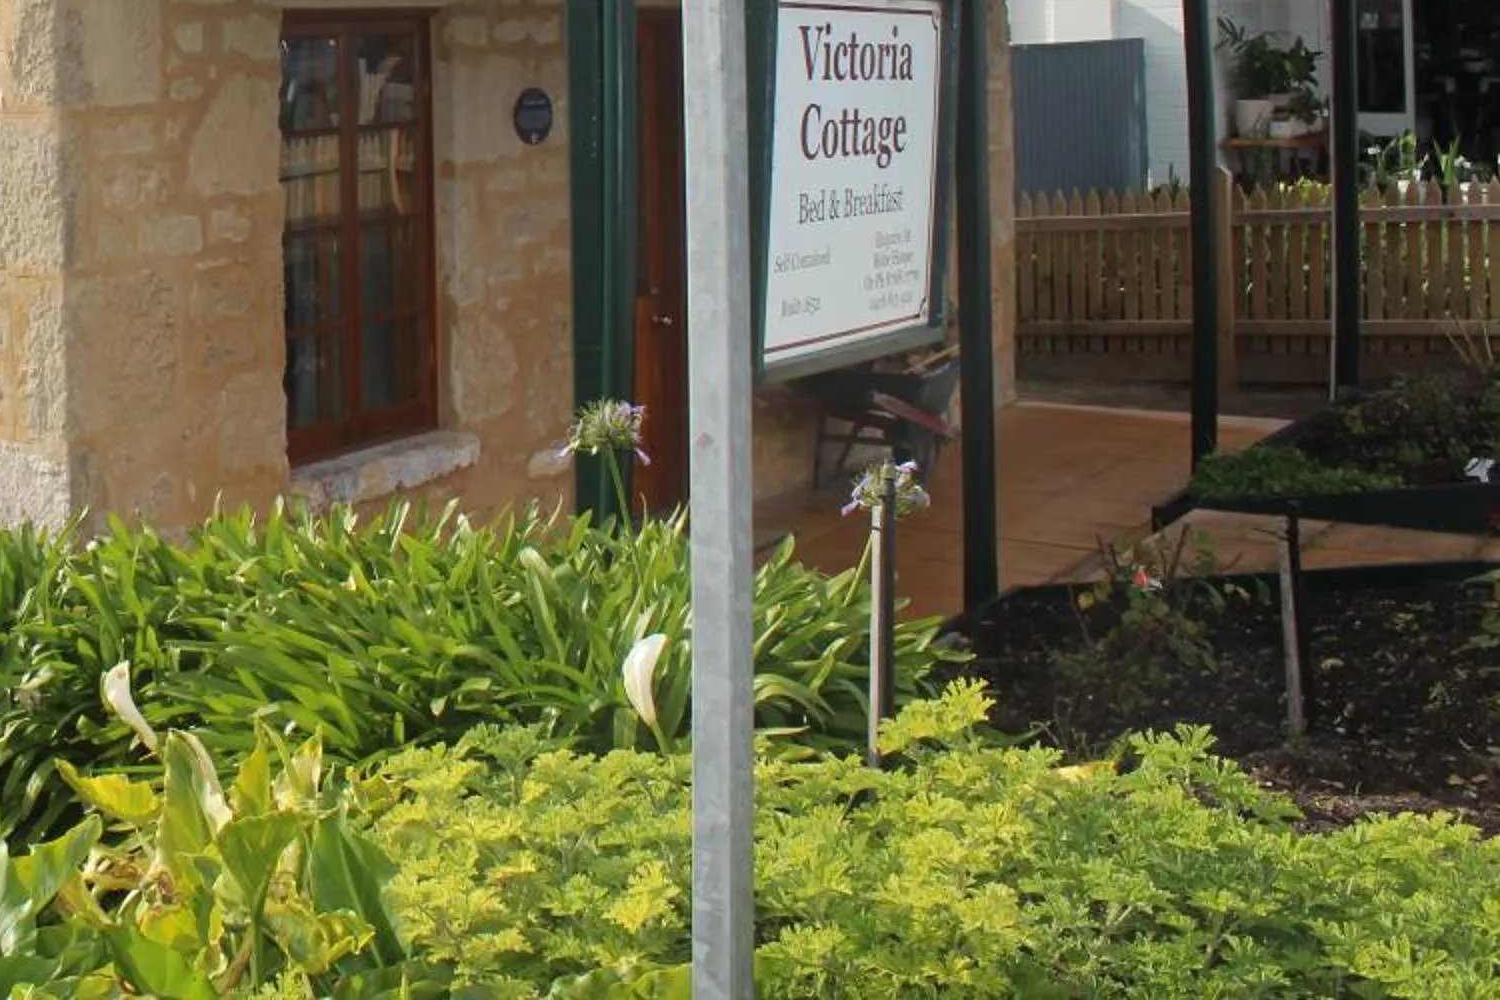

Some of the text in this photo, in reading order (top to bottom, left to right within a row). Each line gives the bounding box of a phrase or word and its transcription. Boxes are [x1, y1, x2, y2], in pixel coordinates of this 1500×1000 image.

[798, 22, 913, 80] Victoria
[801, 103, 907, 169] Cottage
[798, 184, 903, 224] Bed & Breakfast
